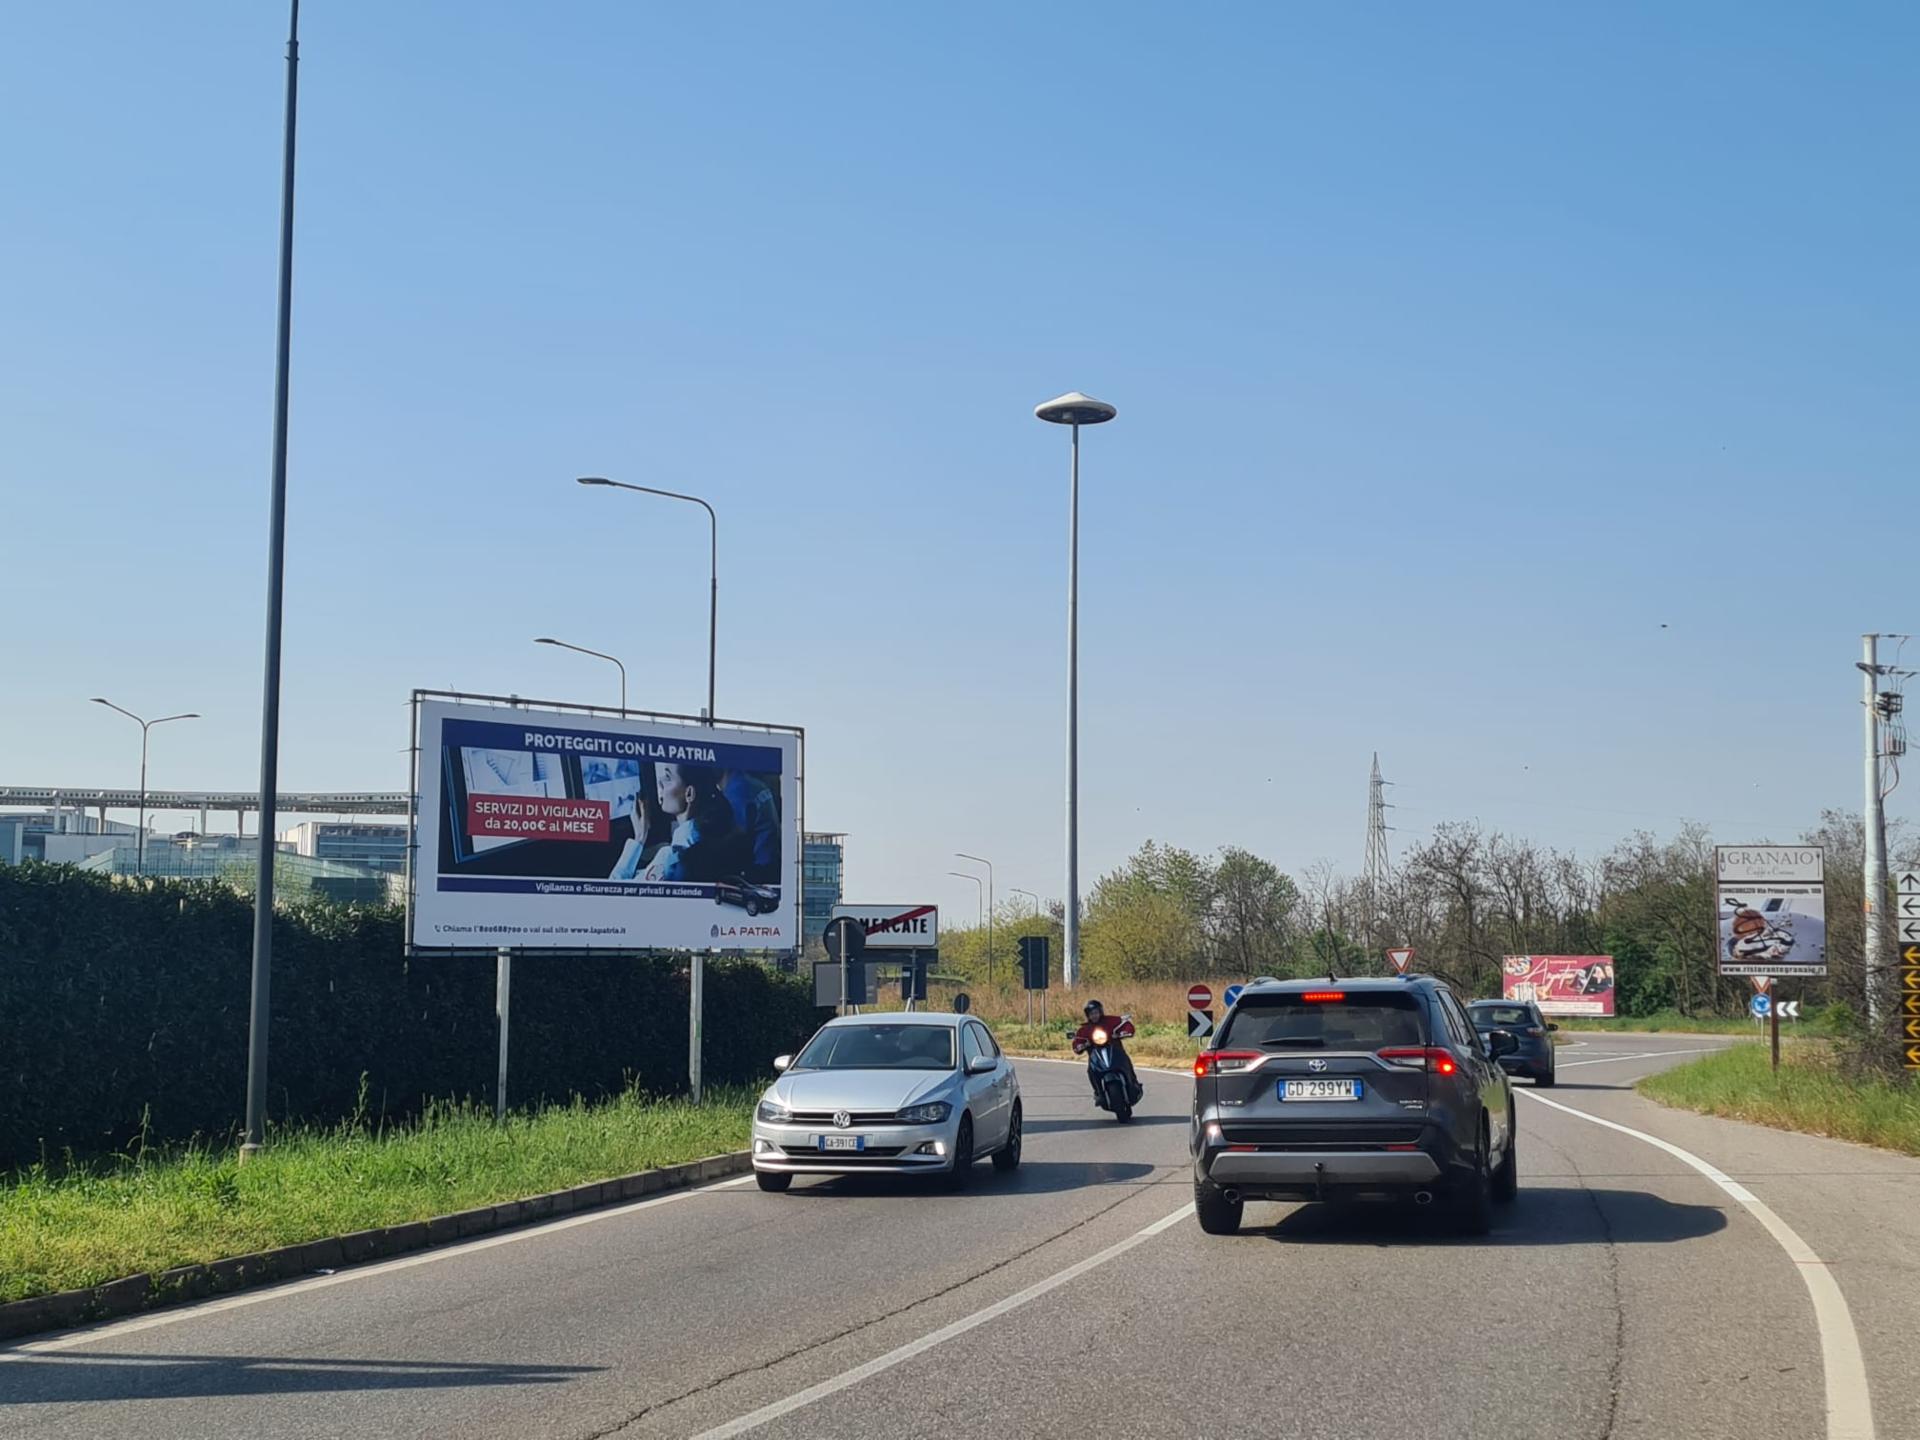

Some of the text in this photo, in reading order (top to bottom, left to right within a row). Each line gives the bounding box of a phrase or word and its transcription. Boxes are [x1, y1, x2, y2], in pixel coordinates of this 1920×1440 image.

[525, 733, 716, 762] PROTEGGITI CON LA PATRIA
[475, 802, 604, 820] SERVIZI DI VIGILANZA
[485, 817, 594, 833] da 20,00€ al MESE
[1727, 851, 1814, 865] GRANAIO
[535, 882, 575, 893] Vigilanza
[583, 884, 623, 893] Sicurezza
[624, 886, 638, 895] per
[639, 885, 665, 896] privati
[665, 887, 671, 895] e
[672, 887, 702, 896] aziende
[442, 924, 473, 933] Chiama
[720, 927, 781, 936] LA PATRIA
[859, 917, 928, 934] MERCATE
